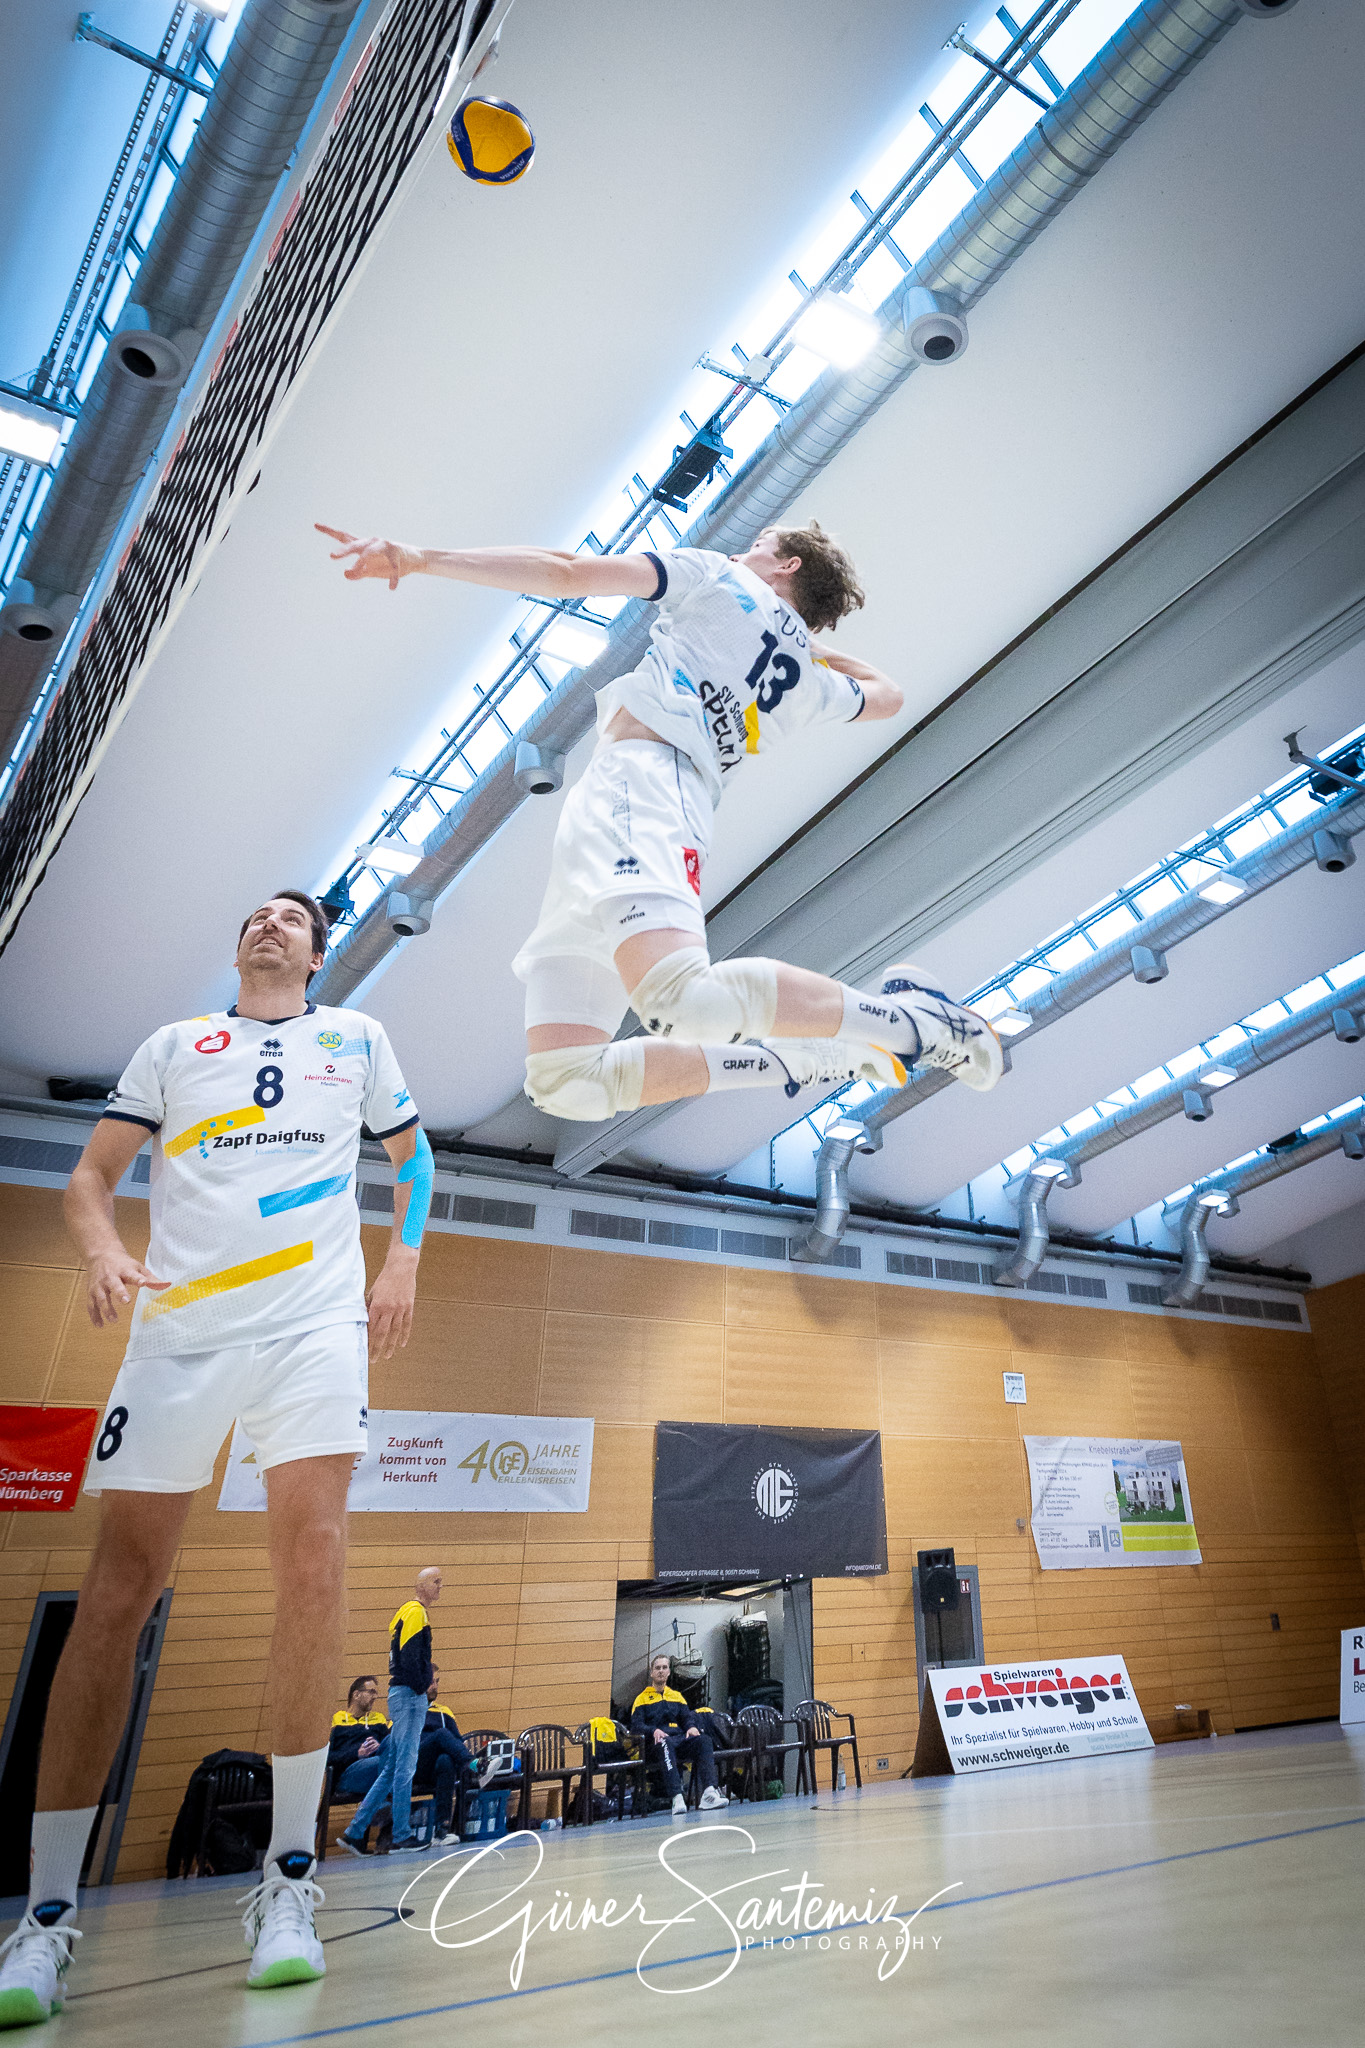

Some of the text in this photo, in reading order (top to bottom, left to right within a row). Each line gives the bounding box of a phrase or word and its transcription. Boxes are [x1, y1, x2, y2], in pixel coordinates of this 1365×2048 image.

[774, 609, 807, 648] US
[745, 629, 801, 714] 13
[719, 685, 750, 743] SV Schwaig
[859, 1003, 888, 1019] CRAFT
[723, 1060, 756, 1070] CRAFT
[253, 1065, 284, 1109] 8
[304, 1075, 353, 1084] Heinzelmann
[212, 1129, 326, 1149] Zapf Daigfuss
[96, 1406, 129, 1462] 8
[387, 1437, 444, 1451] ZugKunft
[379, 1453, 447, 1466] kommt von
[532, 1444, 582, 1461] JAHRE
[0, 1468, 73, 1484] Sparkasse
[382, 1471, 438, 1483] Herkunft
[526, 1467, 578, 1476] EISENBAHN
[497, 1475, 577, 1485] ERLEBNISREISEN
[993, 1668, 1055, 1682] Spielwaren
[943, 1667, 1127, 1718] schweiger
[950, 1715, 1139, 1747] Ihr Spezialist für Spielwaren, Hobby und Schule
[957, 1742, 1071, 1768] www.schweiger.de
